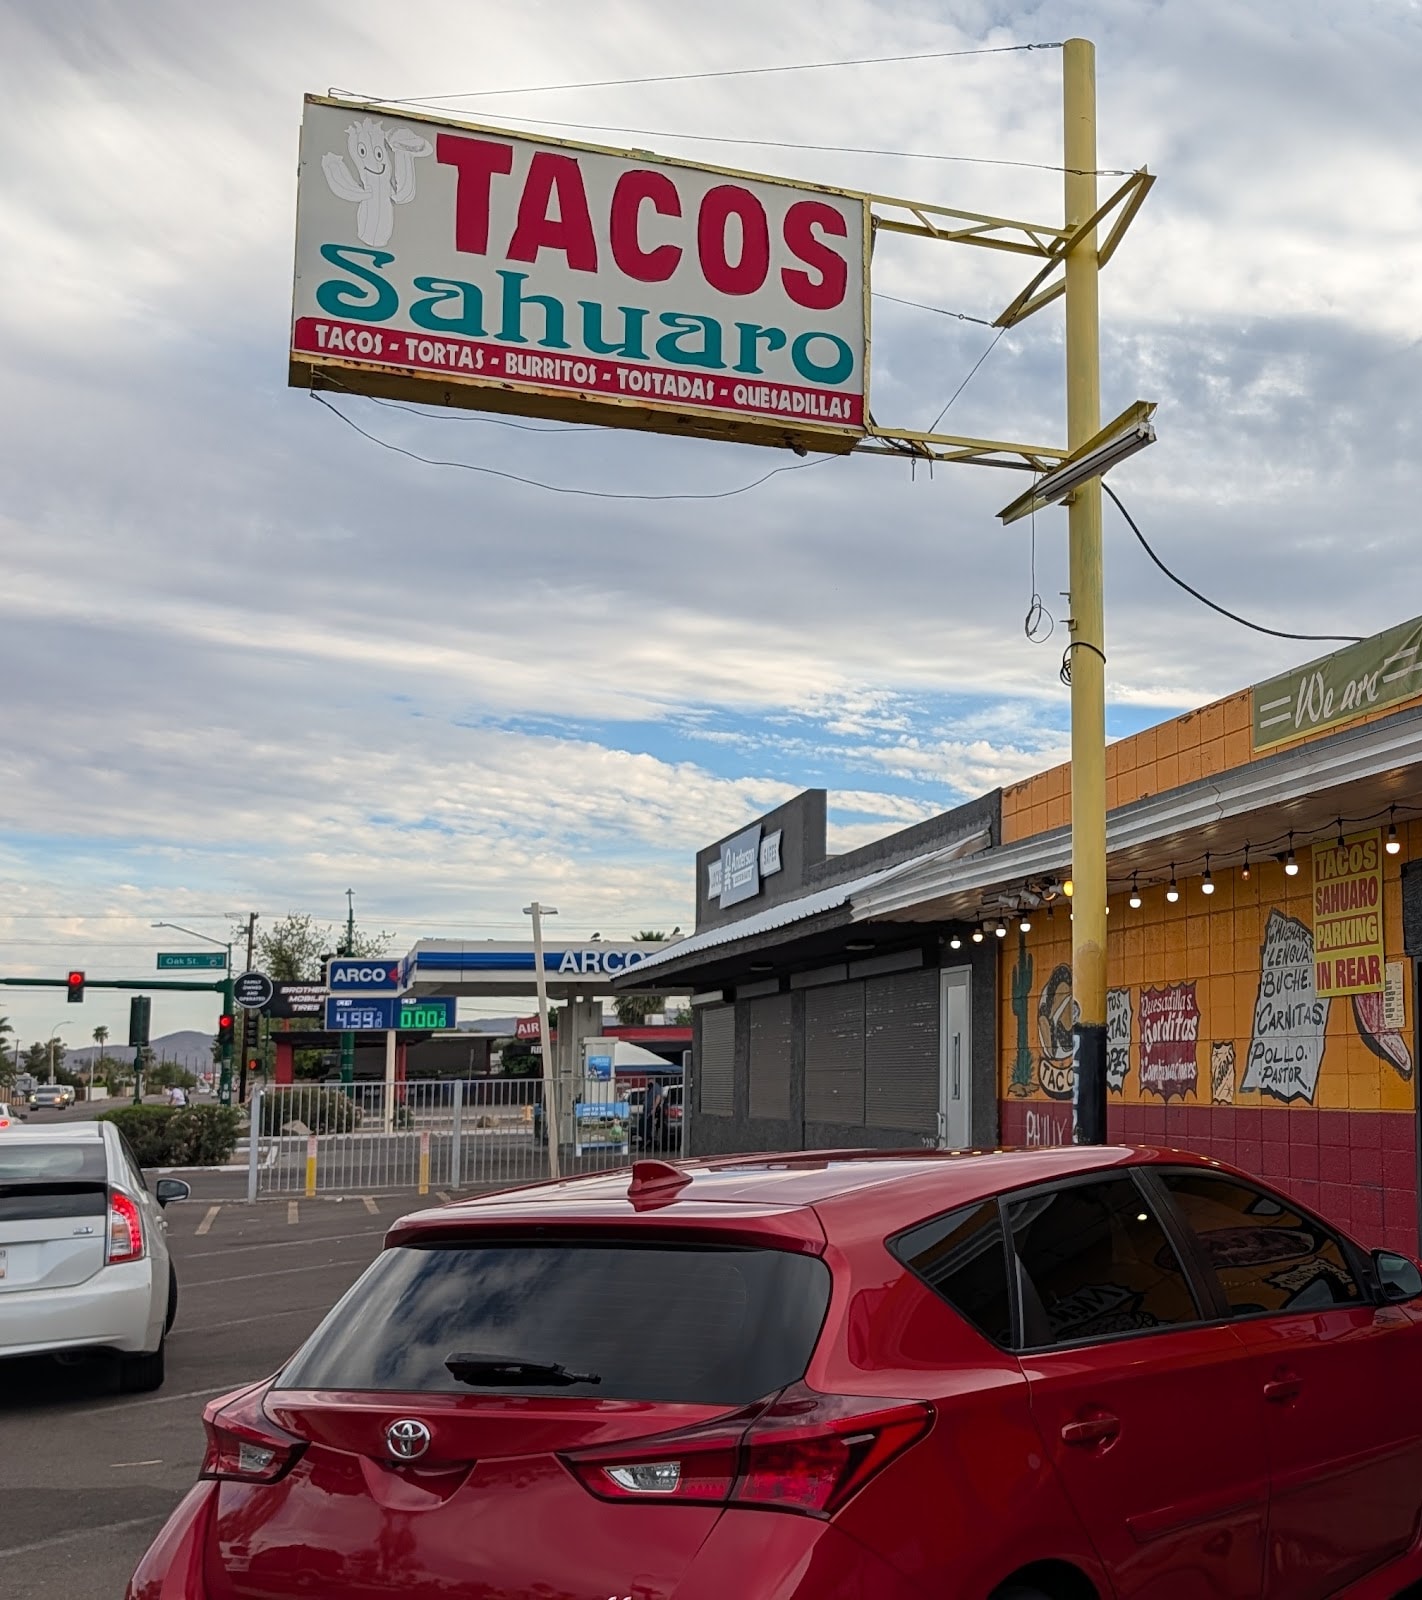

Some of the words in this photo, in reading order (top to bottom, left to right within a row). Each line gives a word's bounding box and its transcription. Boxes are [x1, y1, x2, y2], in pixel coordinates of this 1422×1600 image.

[436, 132, 848, 310] TACOS
[316, 244, 855, 384] Sahuaro
[315, 324, 383, 355] TACOS
[405, 337, 484, 369] TORTAS
[505, 352, 597, 384] BURRITOS
[617, 368, 714, 400] TOSTADAS
[733, 384, 851, 419] QUESADILLAS
[1295, 672, 1334, 729] We
[1340, 671, 1379, 711] are
[1316, 840, 1378, 880] TACOS
[1316, 875, 1379, 916] SAHUARO
[1316, 914, 1379, 951] PARKING
[166, 957, 185, 965] Oak
[558, 949, 647, 974] ARCO
[1316, 959, 1332, 991] IN
[1336, 955, 1382, 989] REAR
[333, 968, 387, 982] ARCO
[280, 986, 328, 995] BROTHER
[288, 995, 325, 1003] MOBILE
[292, 1004, 321, 1012] TIRES
[336, 1011, 374, 1029] 4.99
[401, 1011, 438, 1028] 0.00
[518, 1022, 540, 1035] AIR
